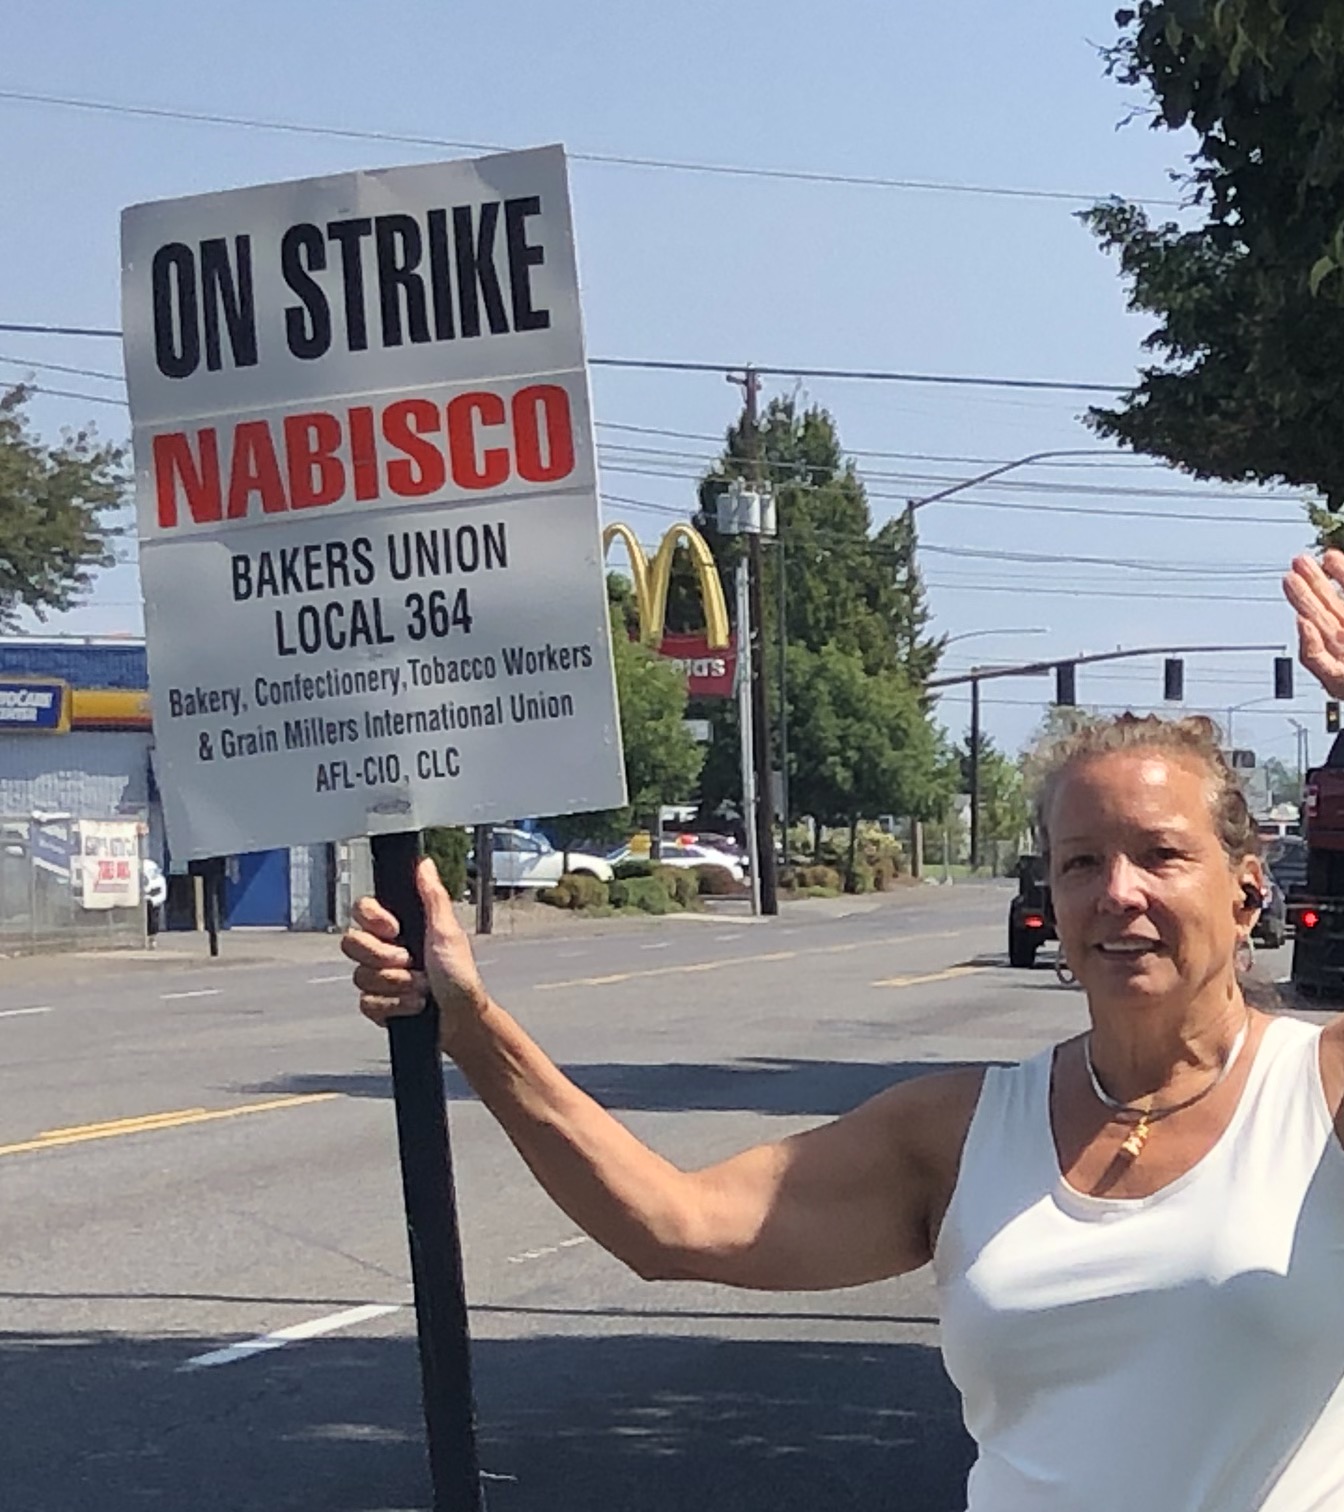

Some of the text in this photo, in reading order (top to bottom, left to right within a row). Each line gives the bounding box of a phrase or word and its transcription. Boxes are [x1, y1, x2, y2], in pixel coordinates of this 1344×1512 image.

[151, 195, 551, 380] ON STRIKE
[152, 383, 576, 529] NABISCO
[231, 521, 509, 602] BAKERS UNION
[275, 588, 474, 657] LOCAL 364
[169, 643, 593, 718] Bakery, Confectionery, Tobacco Workers
[199, 690, 574, 761] & Grain Millers International Union
[316, 747, 461, 793] AFL-CIO, CLC
